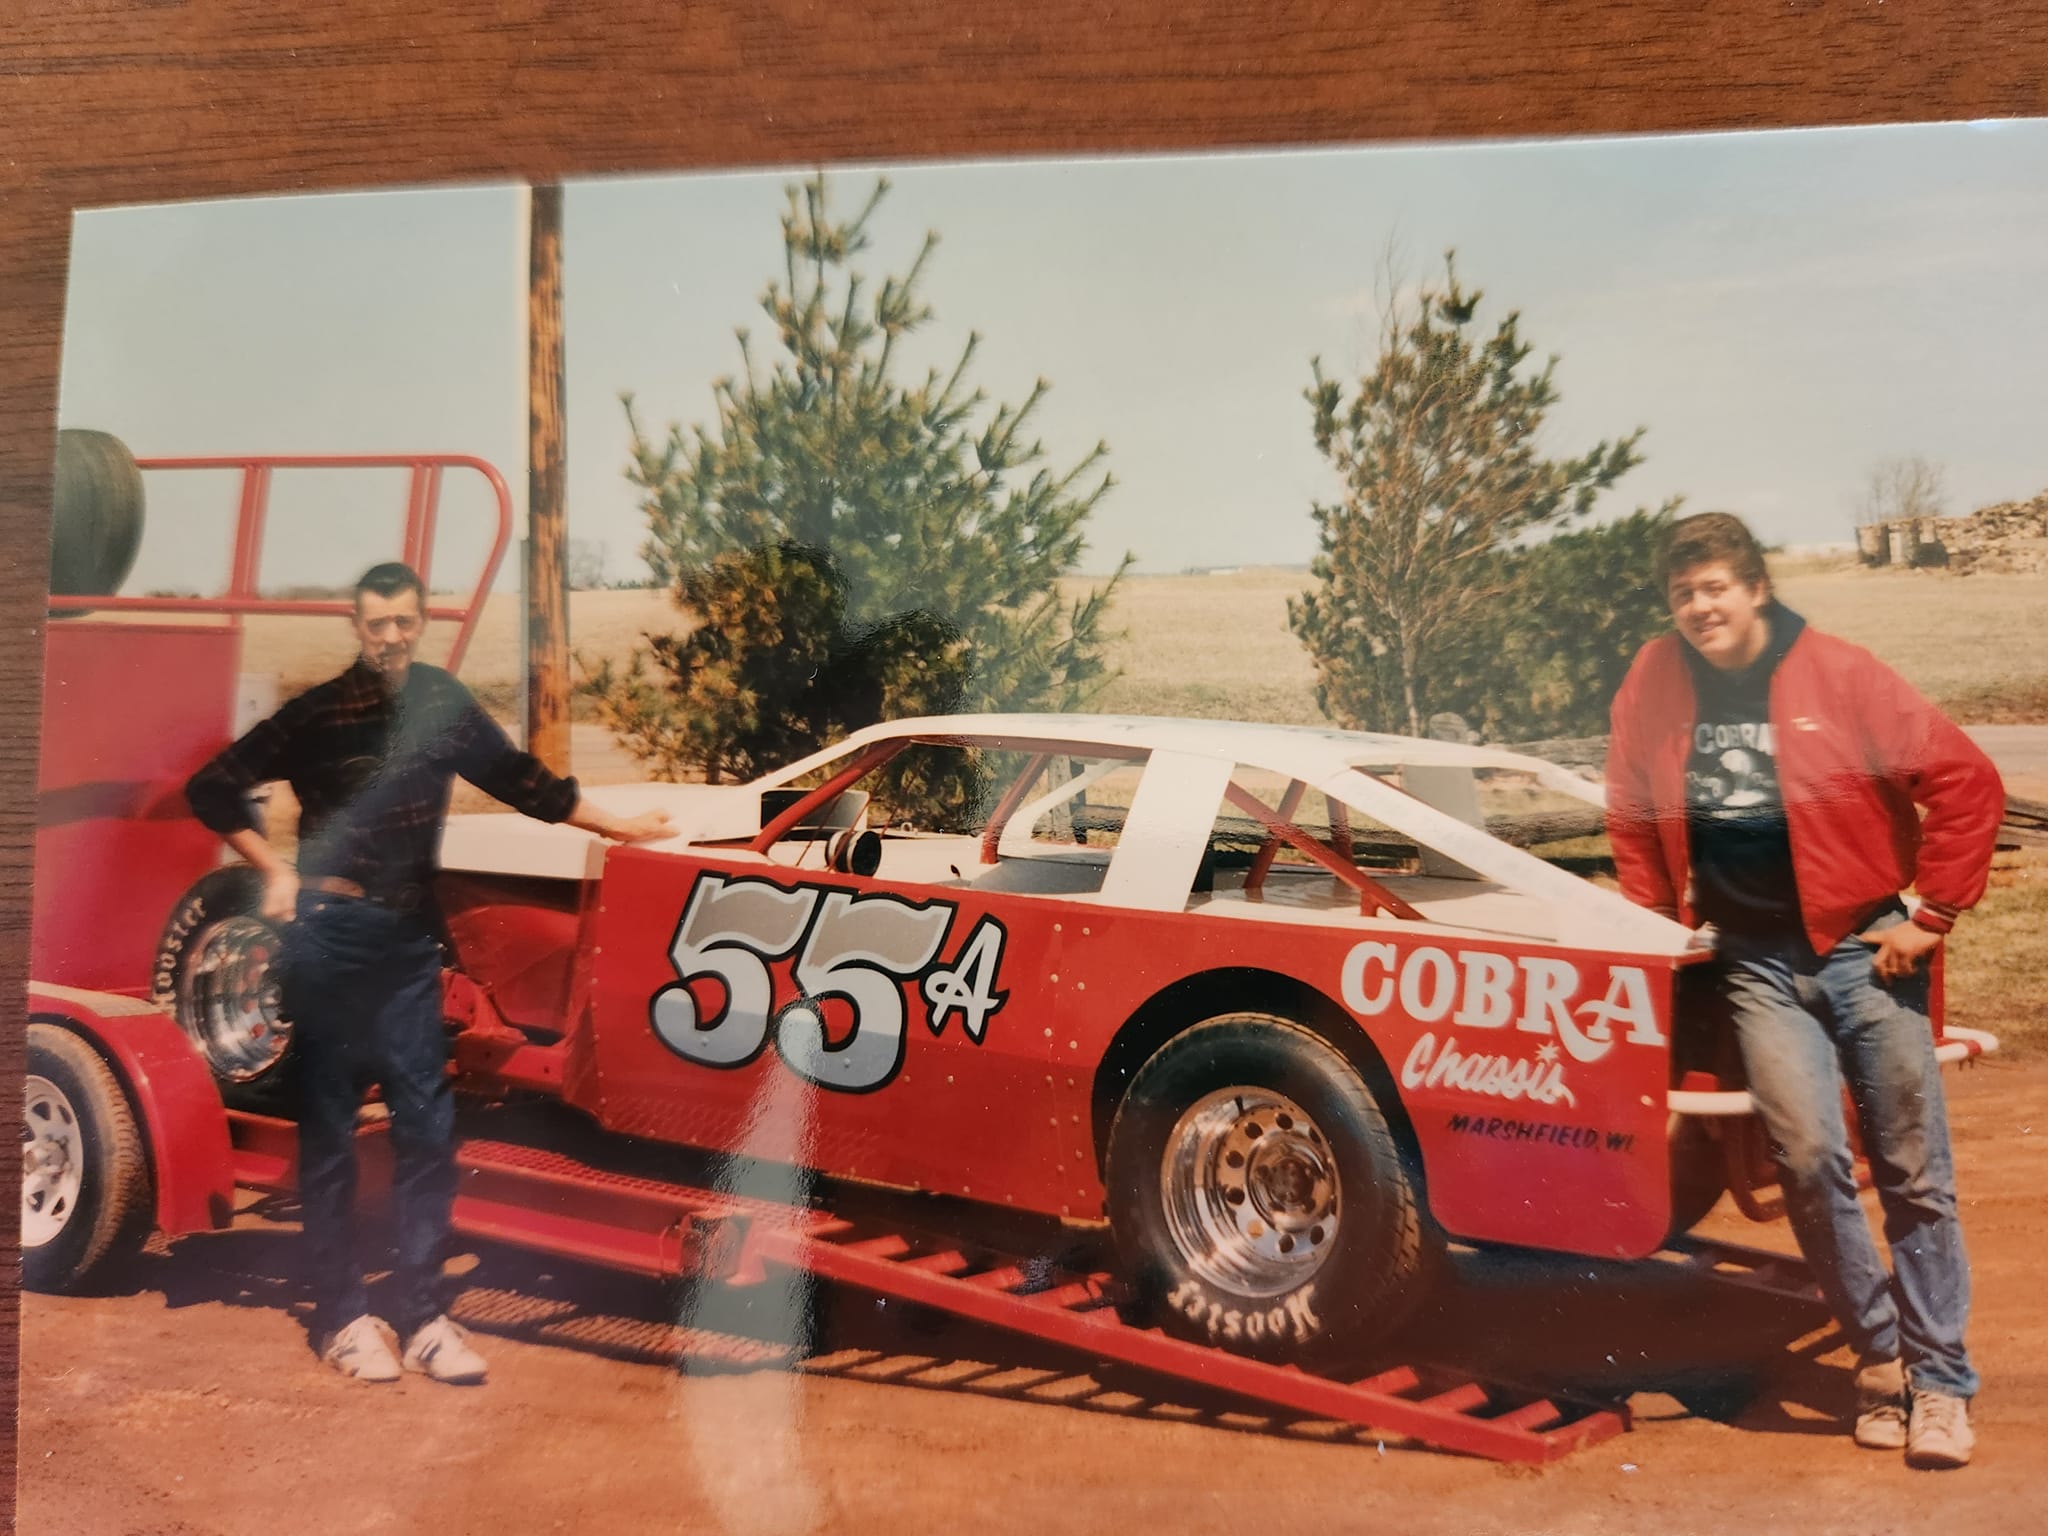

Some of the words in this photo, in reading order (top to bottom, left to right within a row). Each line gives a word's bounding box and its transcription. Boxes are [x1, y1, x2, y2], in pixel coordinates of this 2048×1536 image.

[1694, 722, 1777, 756] COBRA
[1341, 940, 1666, 1062] COBRA
[1402, 1032, 1576, 1109] Chassis
[1605, 1131, 1636, 1153] WI
